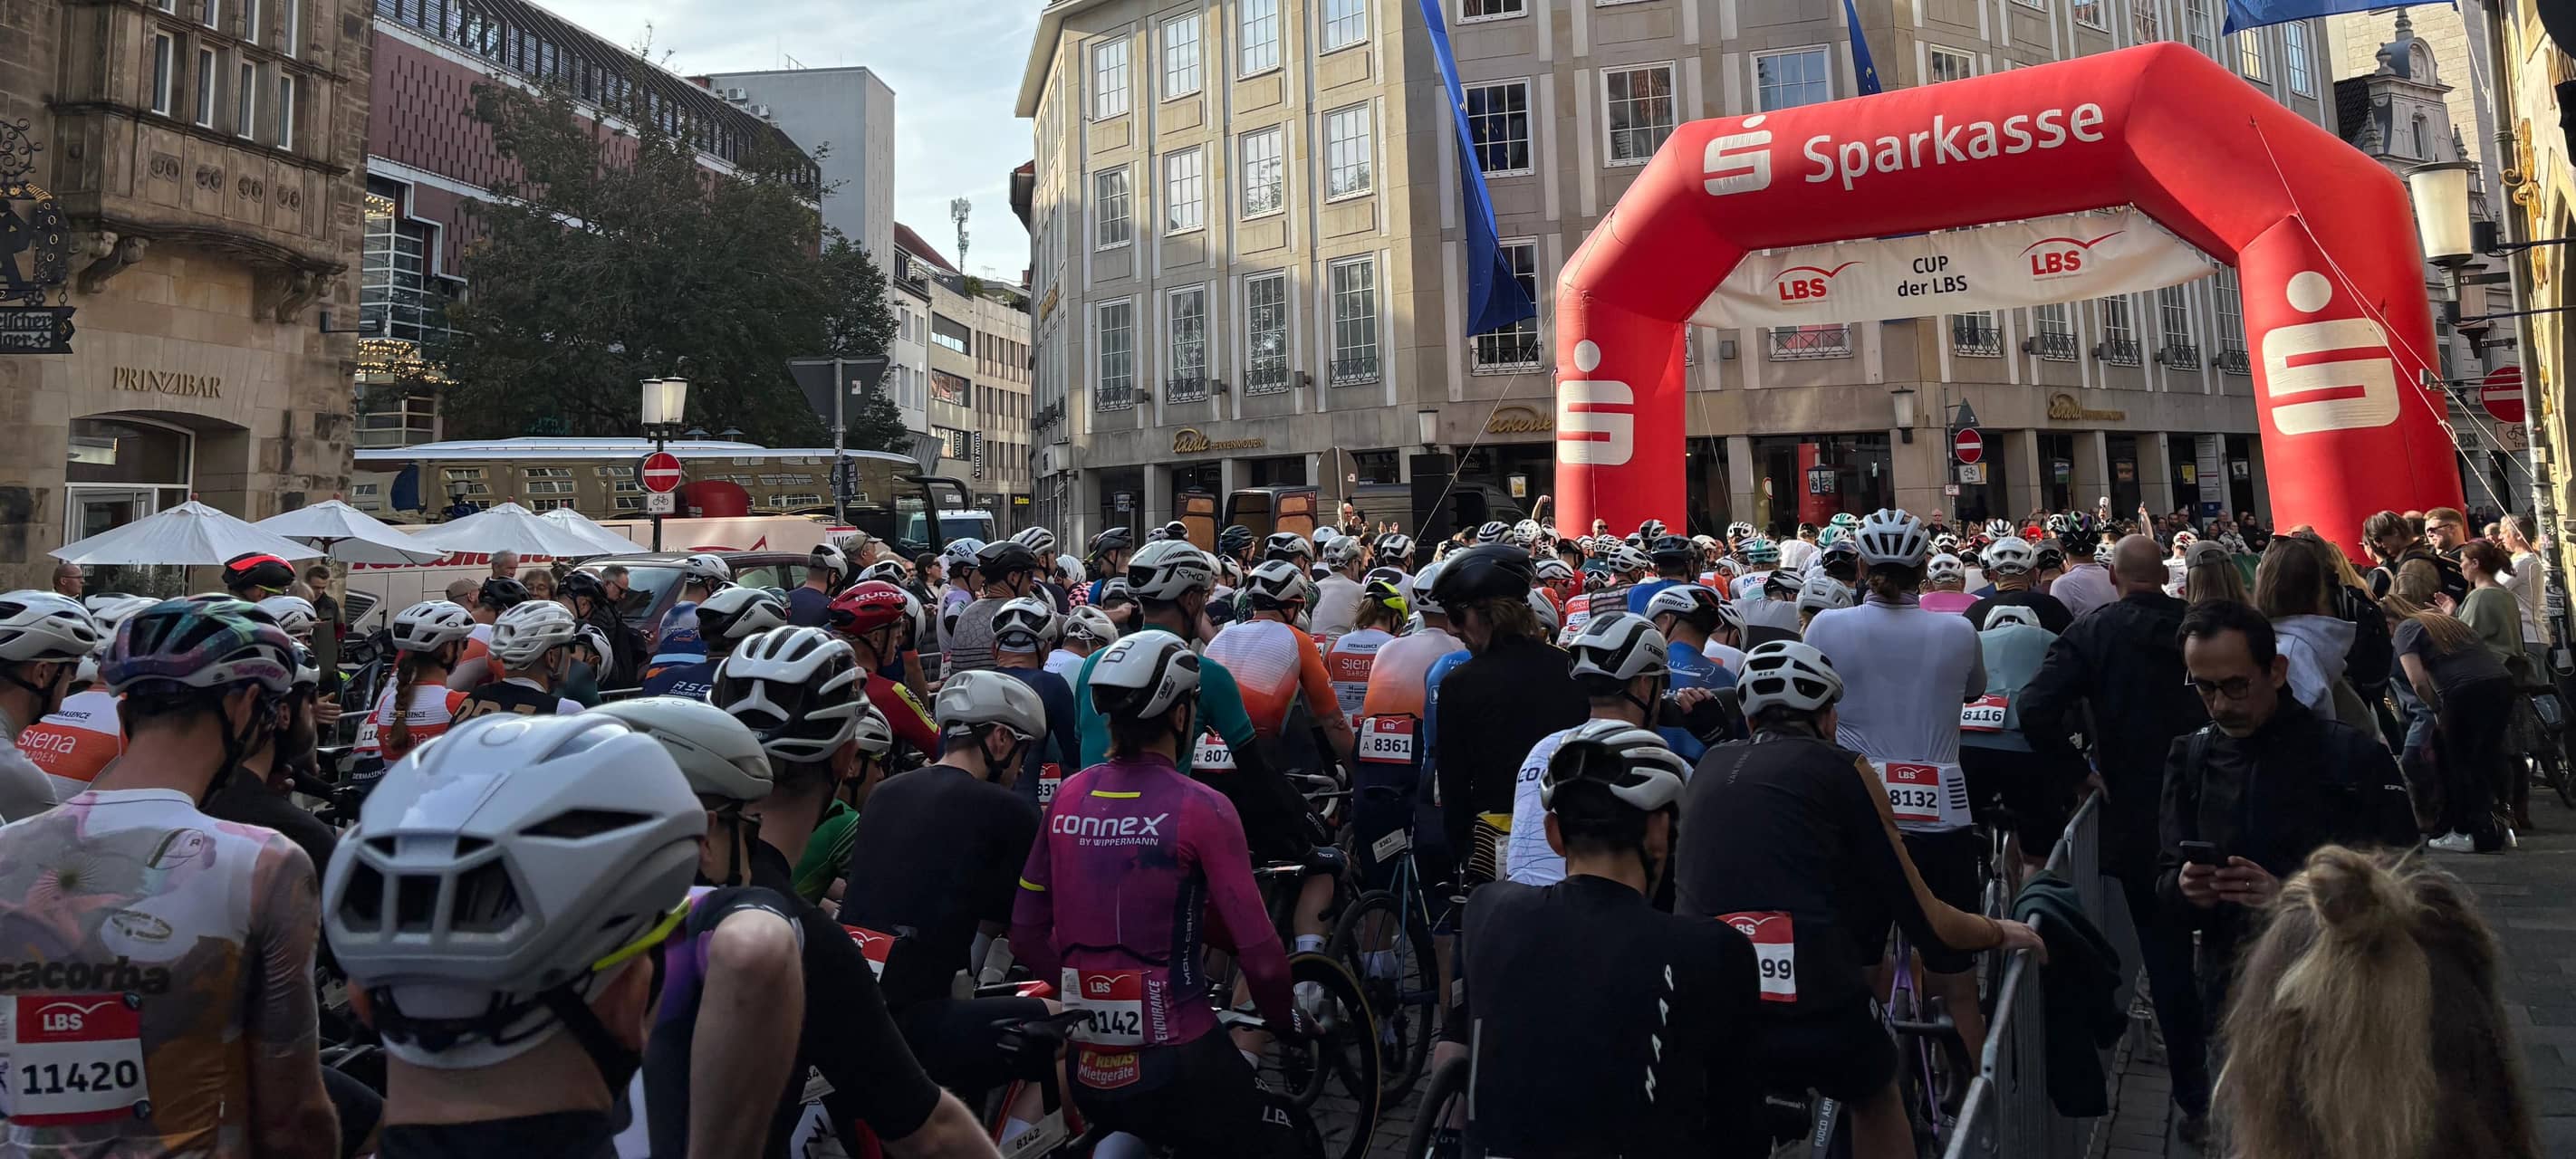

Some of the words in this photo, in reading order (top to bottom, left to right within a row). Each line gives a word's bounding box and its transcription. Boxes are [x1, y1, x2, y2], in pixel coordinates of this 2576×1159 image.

[1804, 102, 2104, 191] Sparkasse
[1912, 254, 1949, 274] CUP
[2031, 249, 2081, 276] LBS
[1778, 277, 1828, 301] LBS
[1898, 279, 1929, 298] der
[1933, 275, 1968, 295] LBS
[112, 366, 222, 399] PRINZIBAR
[1341, 657, 1371, 670] sien
[1962, 709, 2003, 723] 8116
[17, 728, 77, 754] siena
[1362, 742, 1370, 752] A
[1374, 738, 1410, 753] 8361
[1898, 771, 1917, 780] LBS
[1889, 789, 1937, 809] 8132
[1052, 812, 1170, 838] connex
[1079, 838, 1091, 847] BY
[1093, 837, 1160, 848] WIPPERMANN
[1089, 981, 1111, 994] LBS
[42, 1012, 84, 1033] LBS
[1088, 1010, 1140, 1036] 8142
[21, 1059, 139, 1096] 11420
